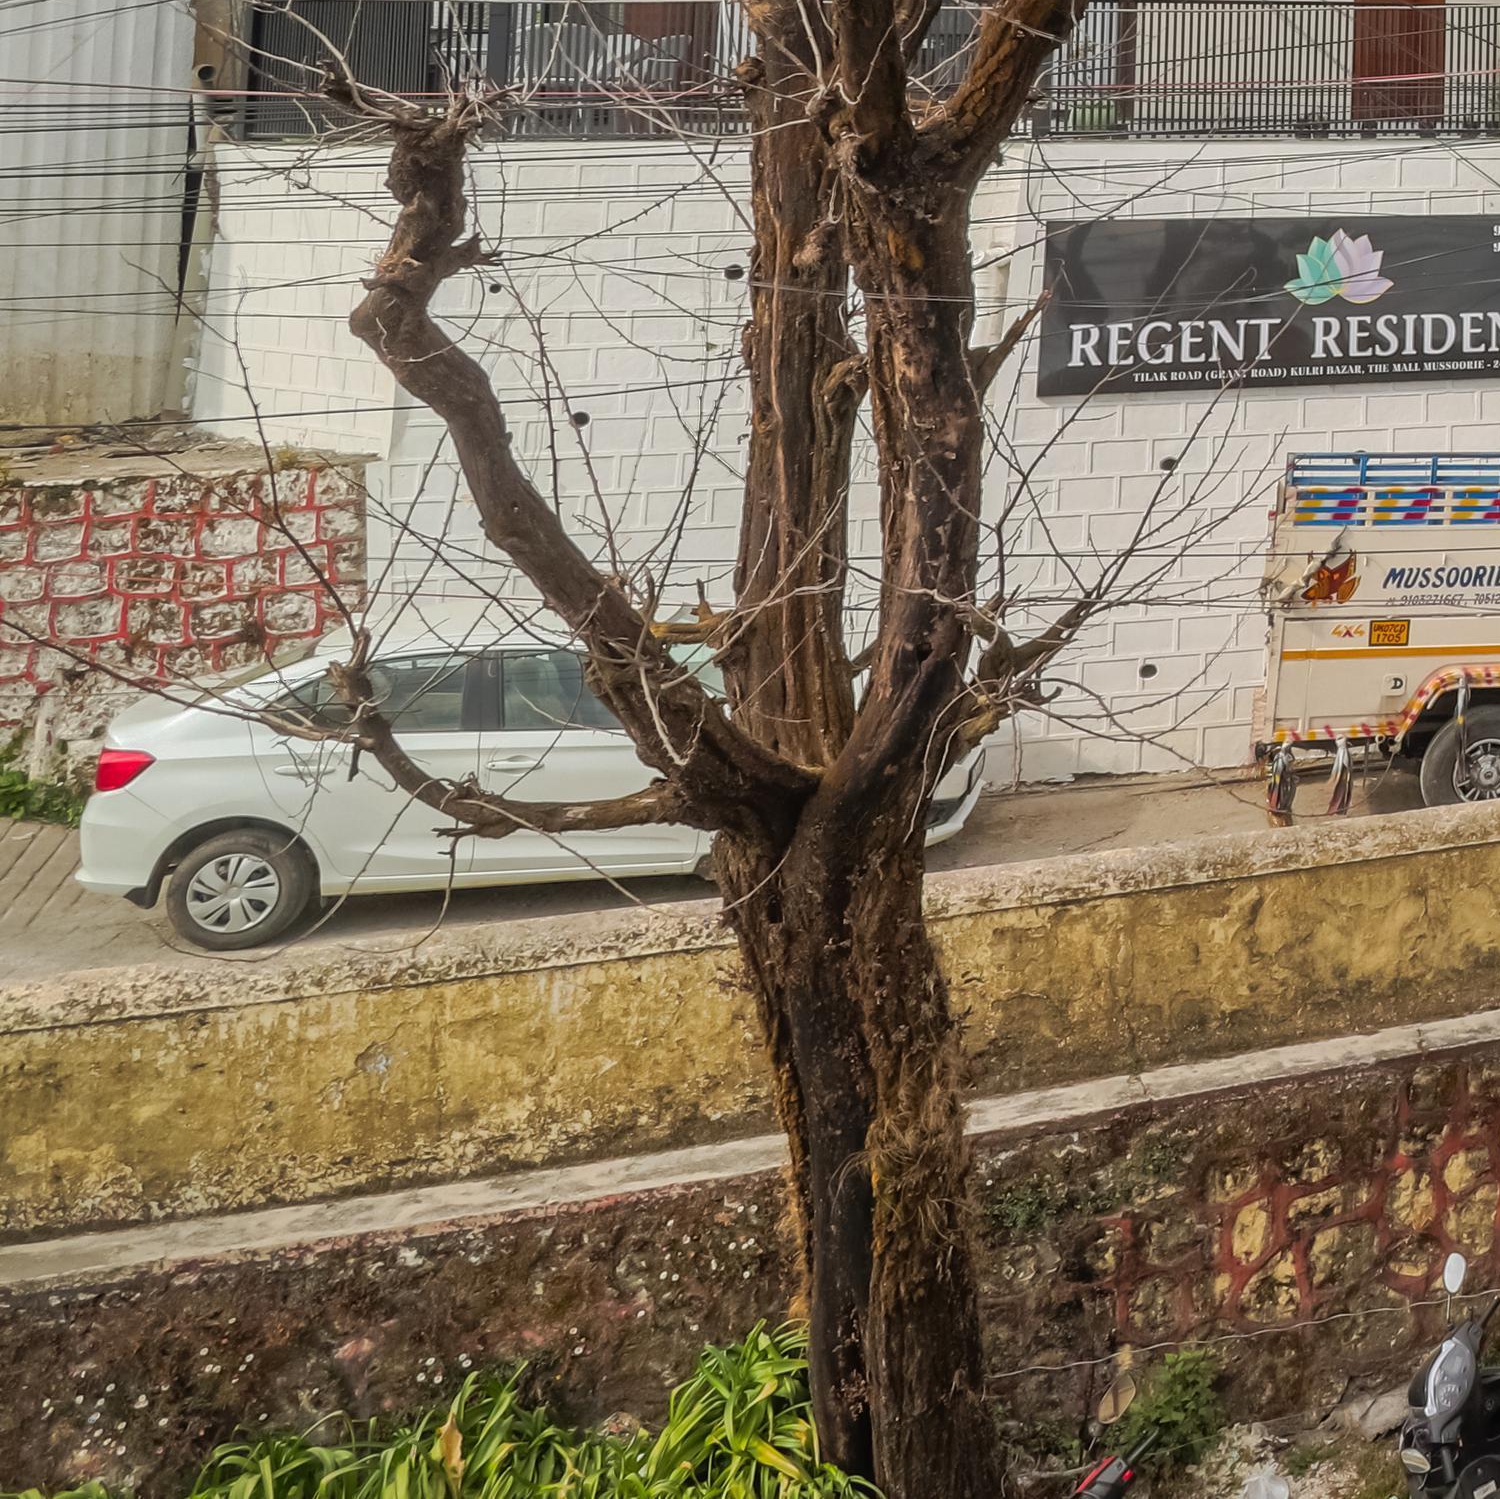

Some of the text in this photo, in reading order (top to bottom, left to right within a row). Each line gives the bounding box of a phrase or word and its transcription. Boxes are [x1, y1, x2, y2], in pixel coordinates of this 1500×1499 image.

[1067, 317, 1281, 367] REGENT
[1133, 373, 1167, 382] TILAK
[1170, 371, 1202, 381] ROAD
[1251, 368, 1287, 378] ROAD)
[1290, 367, 1324, 377] KULRI
[1326, 365, 1365, 375] BAZAR,
[1368, 363, 1389, 373] THE
[1392, 362, 1420, 372] MALL
[1423, 360, 1485, 371] MUSSOORIE
[1376, 633, 1401, 643] 1705
